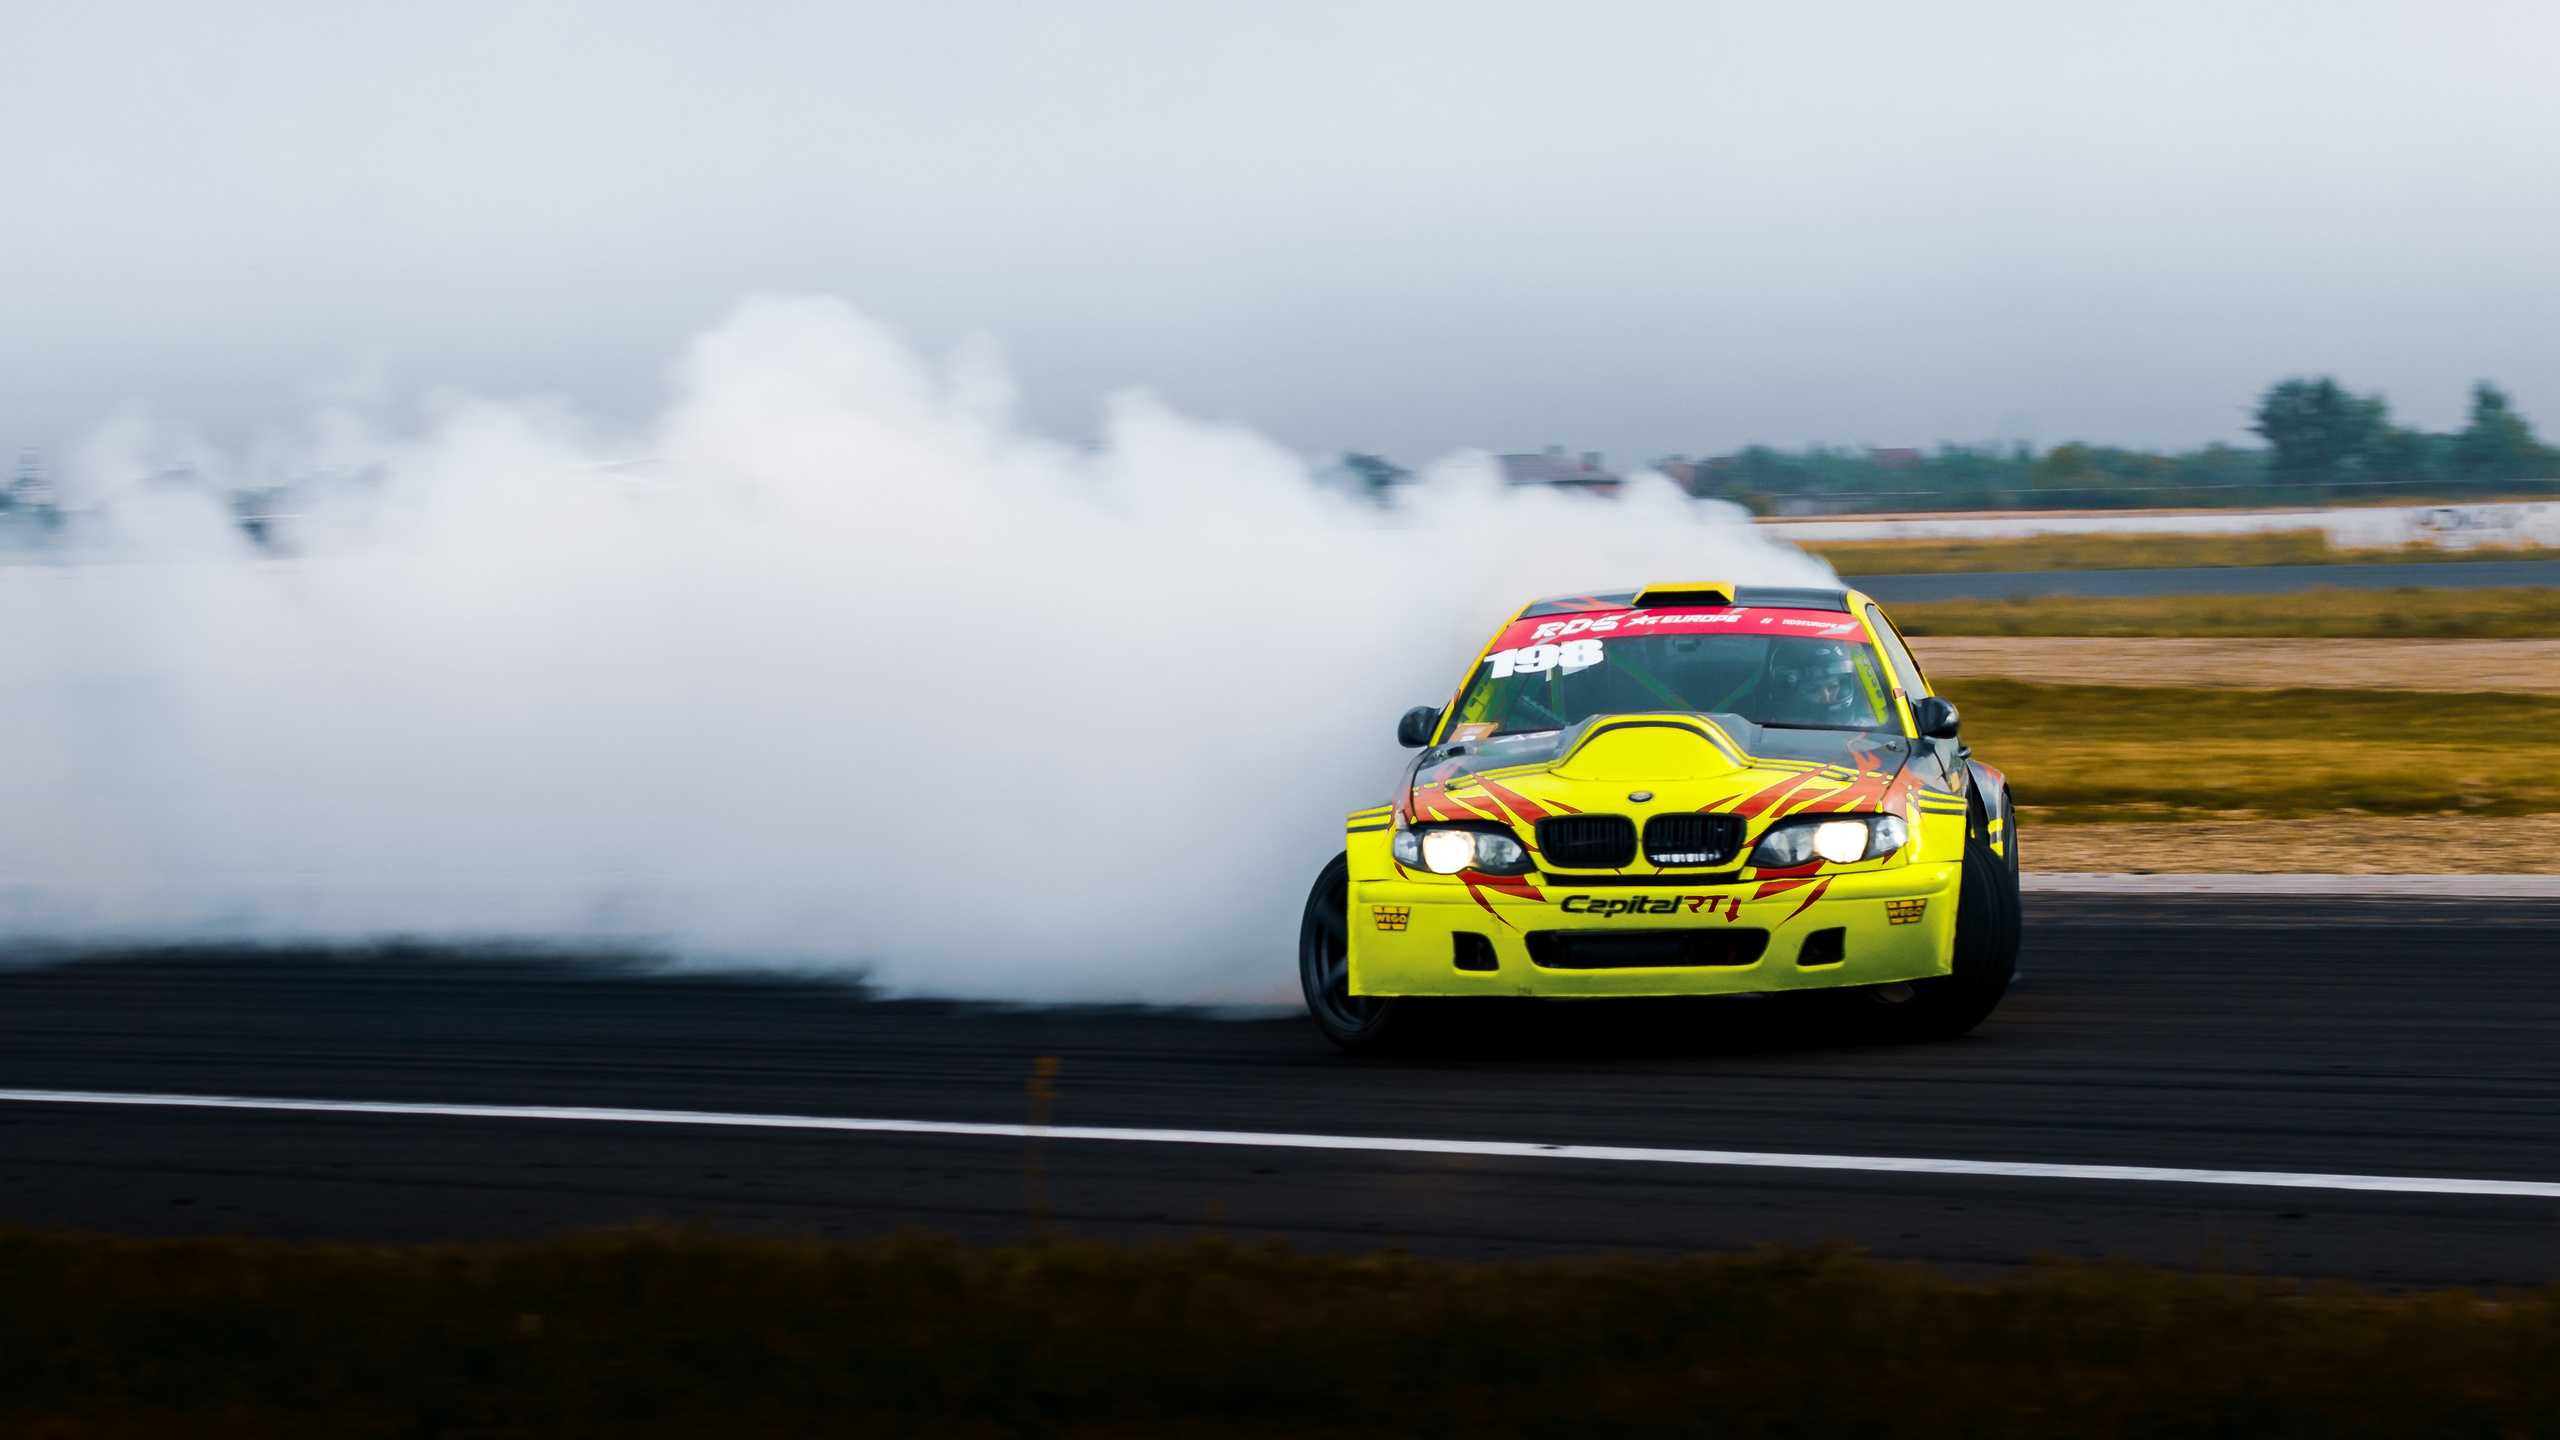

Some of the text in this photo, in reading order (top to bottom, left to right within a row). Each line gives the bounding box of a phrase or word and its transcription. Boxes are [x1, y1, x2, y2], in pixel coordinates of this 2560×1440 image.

[1530, 615, 1852, 639] RDS EUROPE RDSEUROPE.RU
[1483, 639, 1604, 679] 198
[1375, 914, 1408, 923] WEGO
